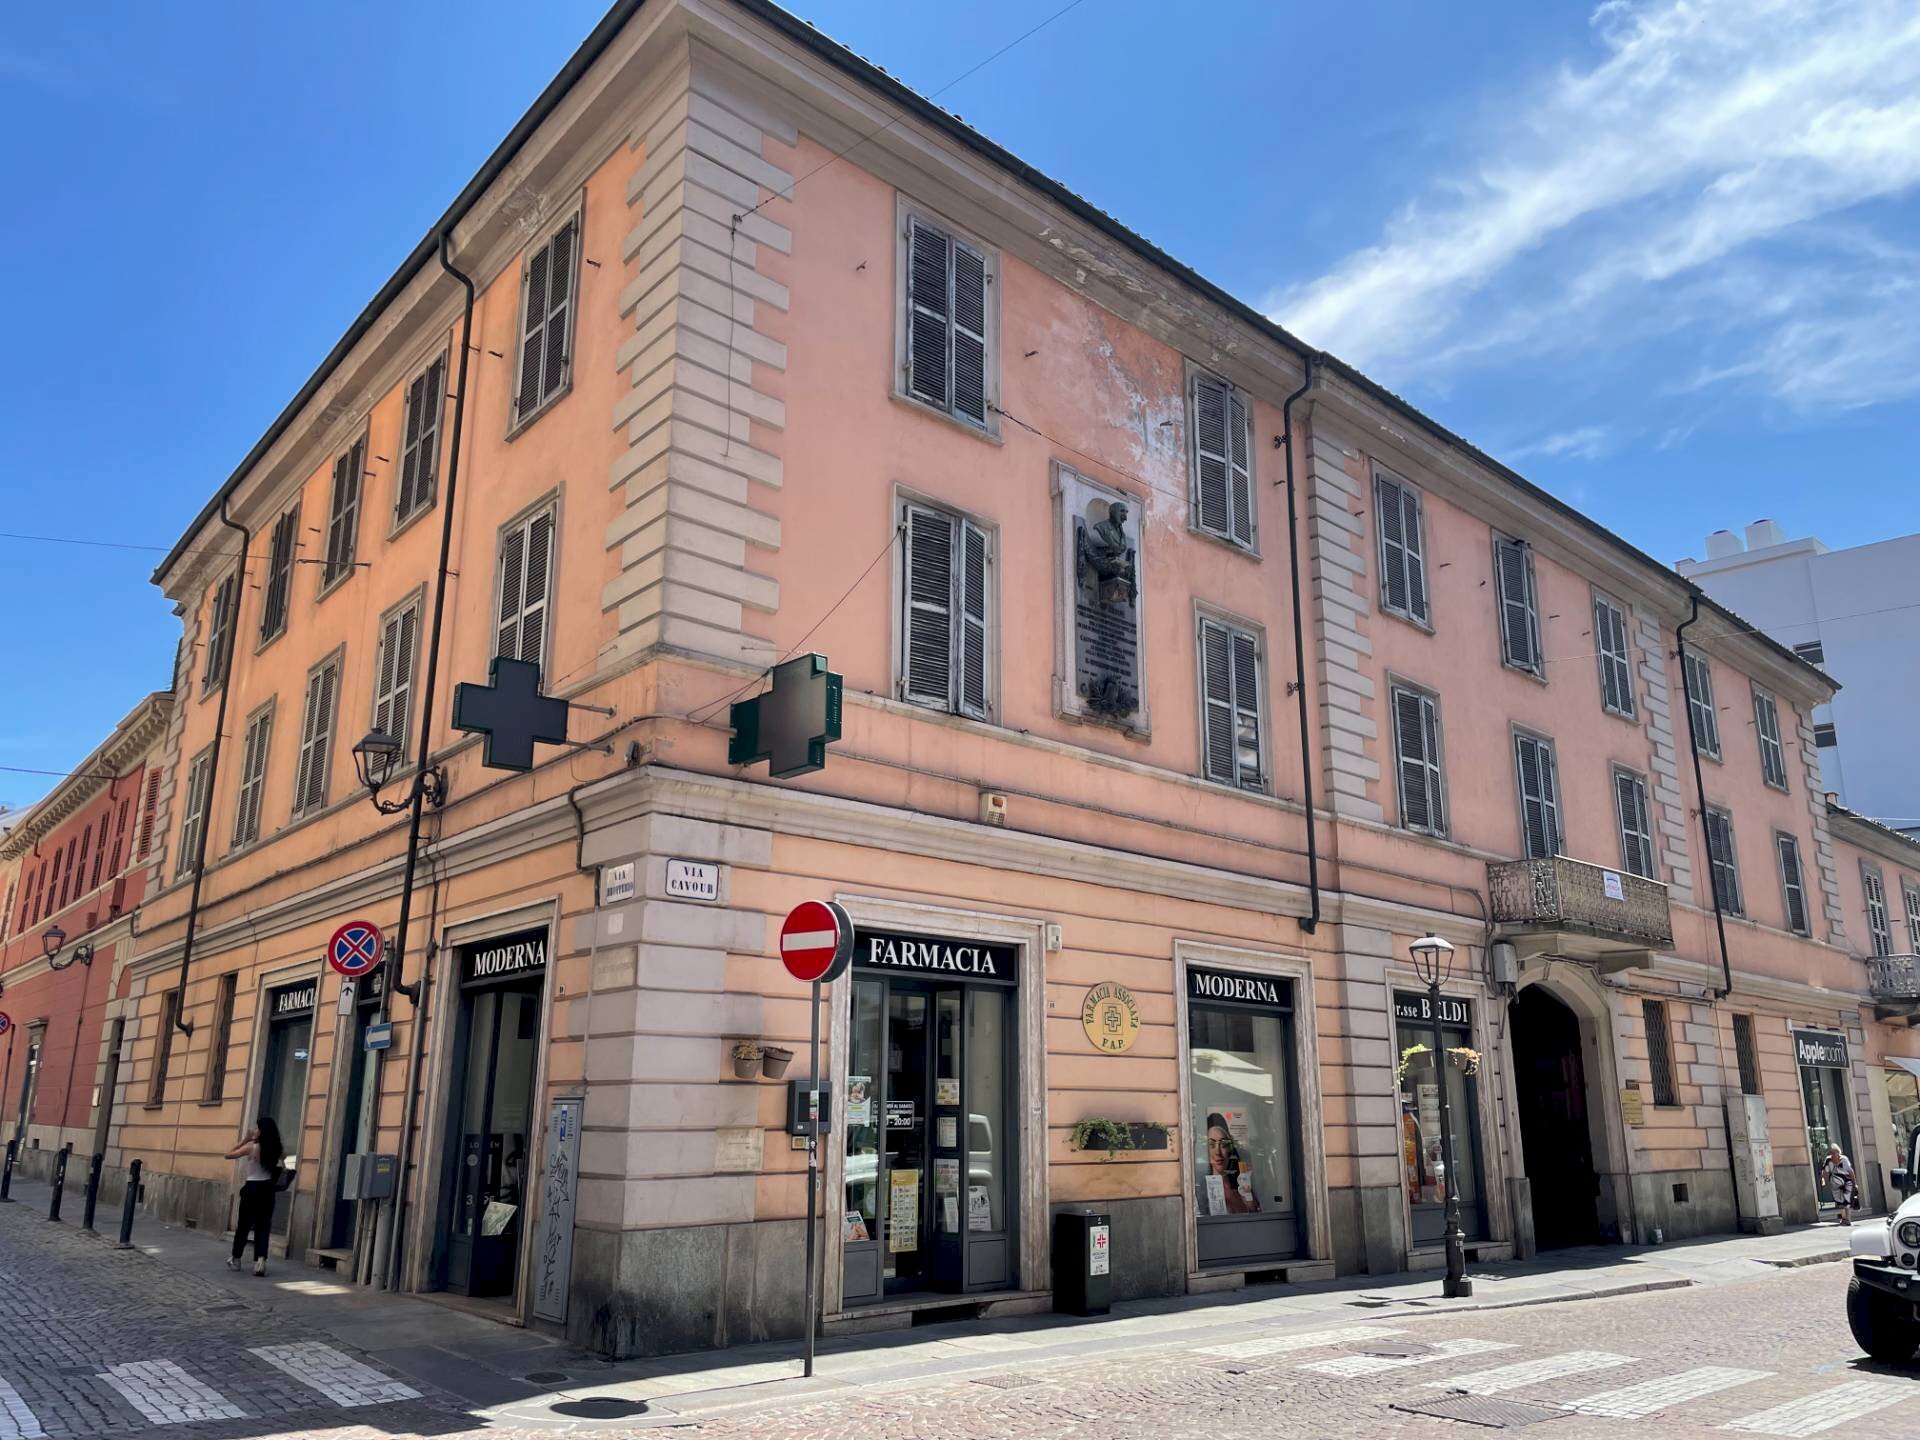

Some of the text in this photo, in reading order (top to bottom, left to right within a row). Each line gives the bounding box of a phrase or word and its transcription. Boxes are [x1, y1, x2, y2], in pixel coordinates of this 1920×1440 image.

[684, 866, 703, 878] VIA
[671, 879, 713, 894] CAVOUR
[473, 939, 546, 977] MODERNA
[869, 937, 997, 974] FARMACIA
[278, 987, 317, 1012] FARMACI
[1194, 973, 1279, 1002] MODERNA
[1085, 986, 1139, 1029] FARMACIA ASSOCIATA
[1394, 998, 1468, 1023] r.sse BLDI
[894, 1117, 911, 1126] 20:00
